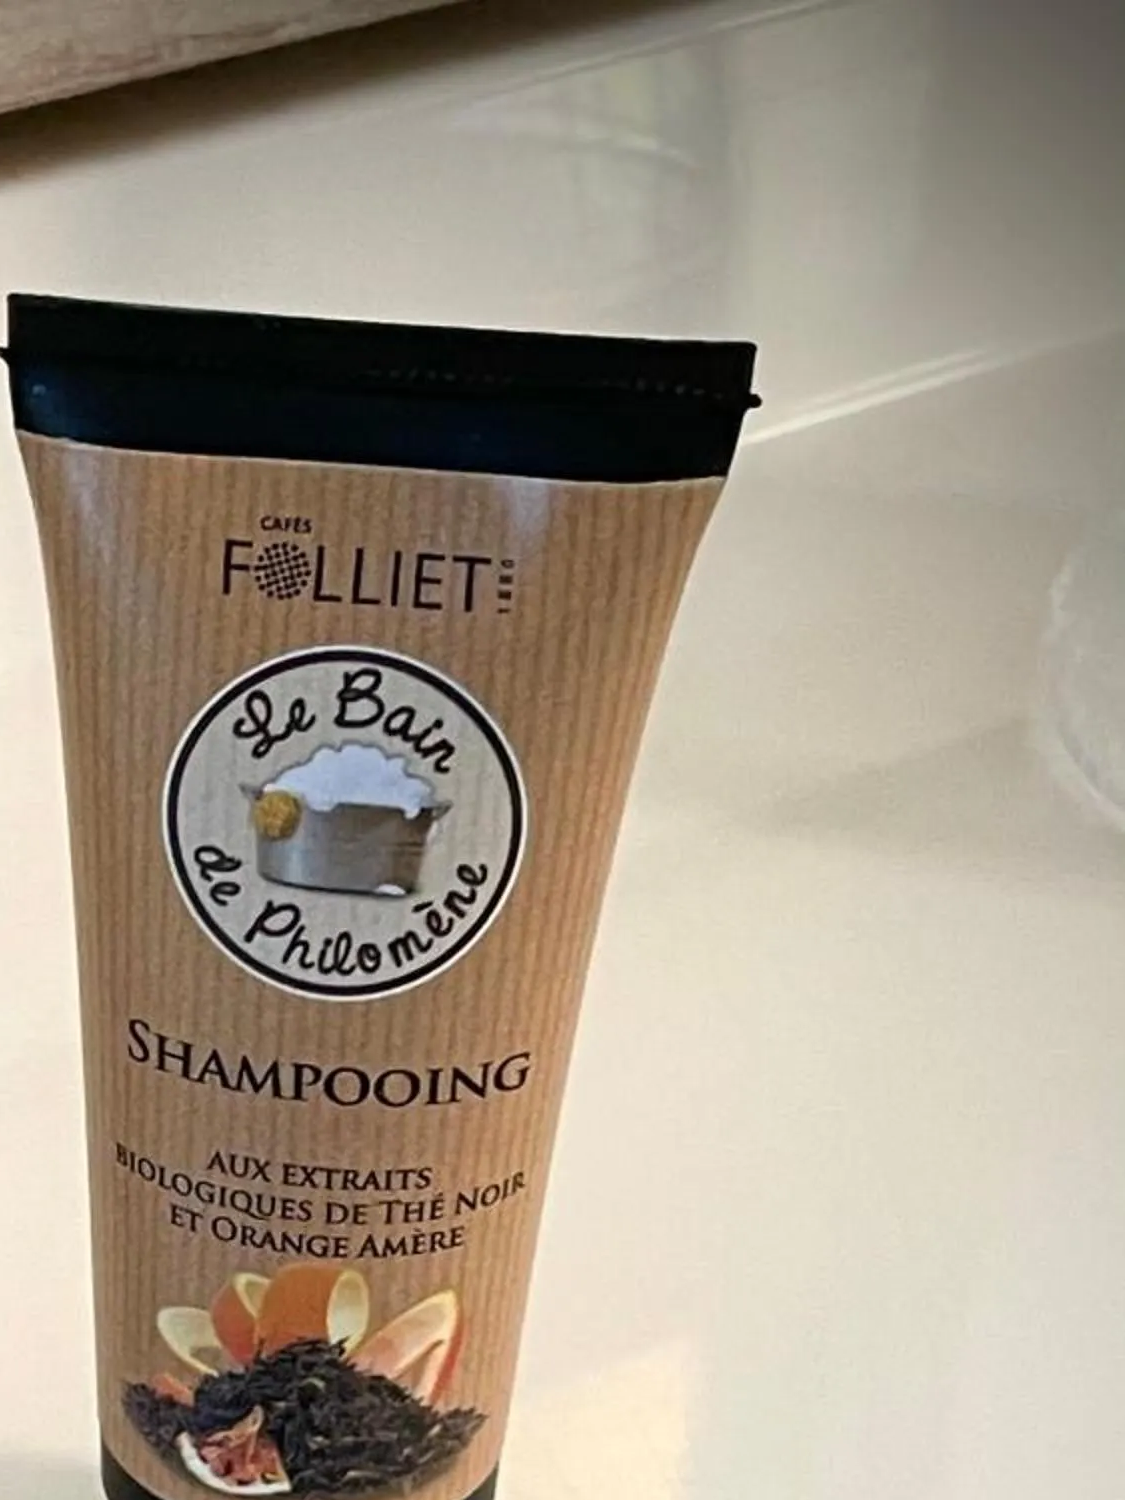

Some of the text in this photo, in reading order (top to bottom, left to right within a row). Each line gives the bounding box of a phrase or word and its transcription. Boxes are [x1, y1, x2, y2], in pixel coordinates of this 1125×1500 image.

[232, 667, 456, 774] Le Bain
[194, 845, 488, 977] de Philomène
[127, 1018, 531, 1108] SHAMPOOING
[115, 1142, 527, 1226] BIOLOGIQUES DE THÉ NOIR
[206, 1151, 432, 1191] AUX EXTRAITS
[169, 1202, 466, 1259] ET ORANGE AMÈRE
